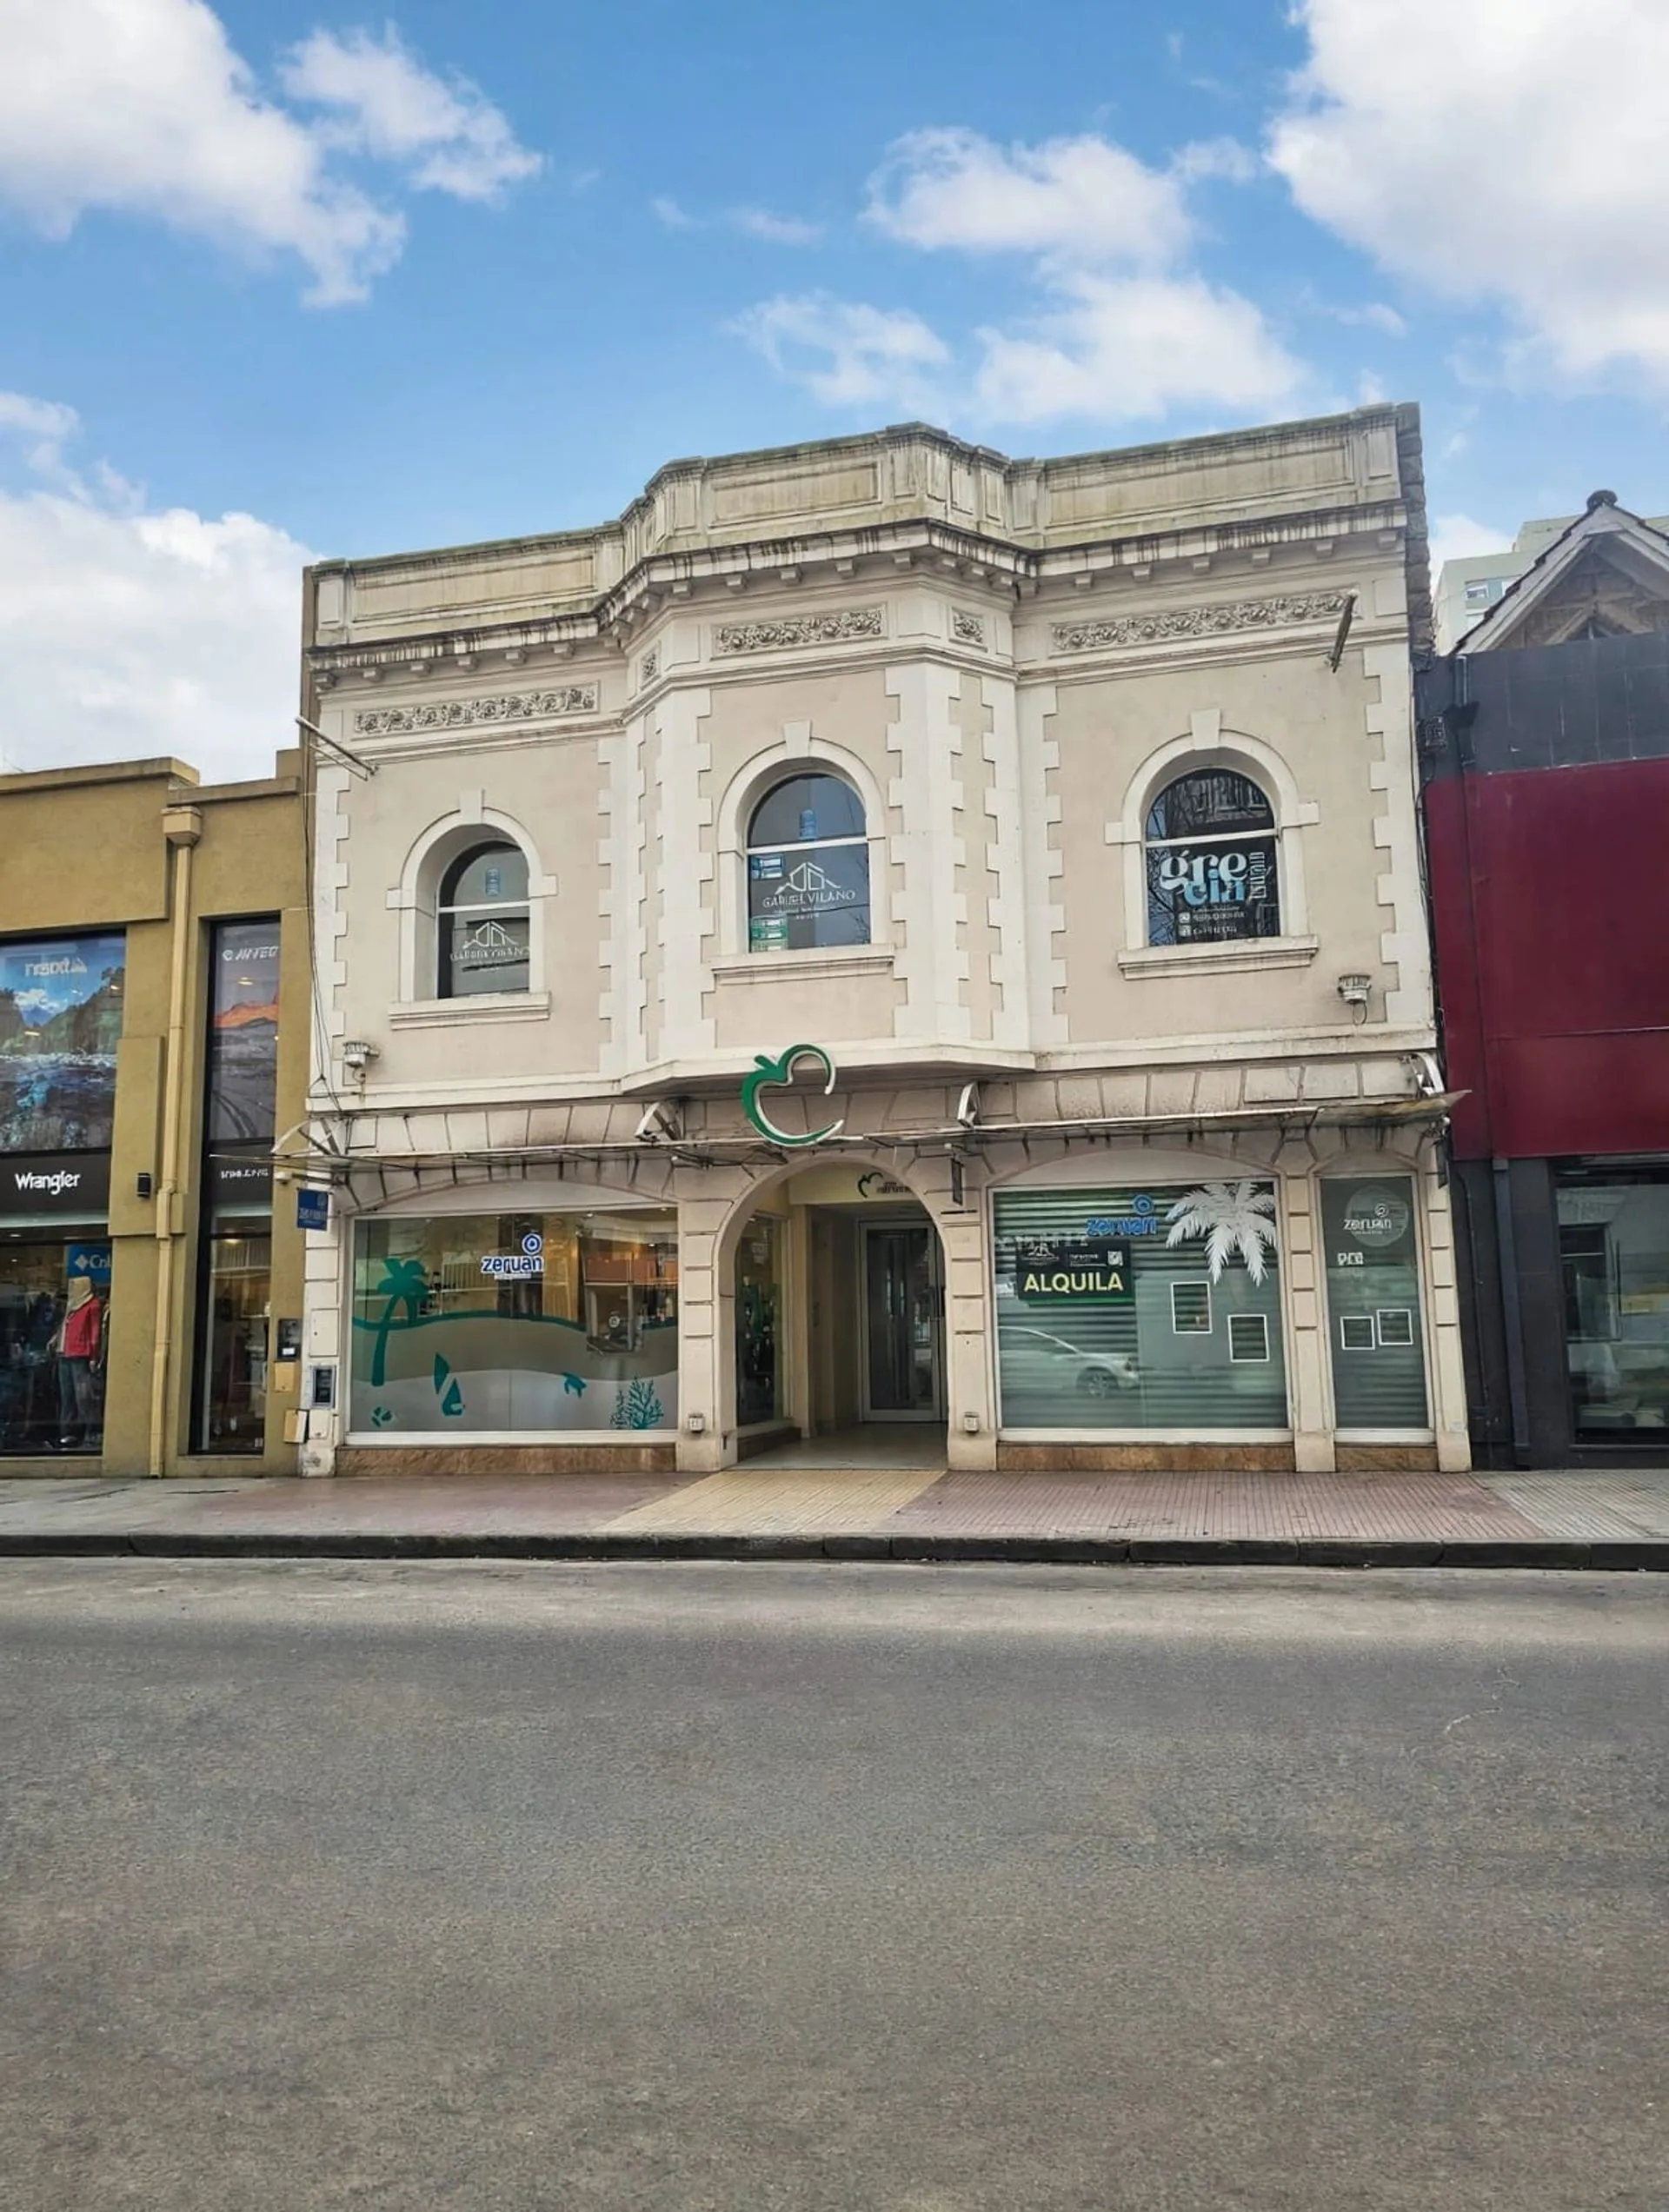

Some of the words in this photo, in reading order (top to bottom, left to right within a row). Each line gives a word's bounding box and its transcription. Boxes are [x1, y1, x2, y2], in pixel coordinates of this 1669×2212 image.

[15, 1170, 81, 1195] Wrangler
[482, 1256, 544, 1273] zeruan
[1024, 1272, 1123, 1293] ALQUILA
